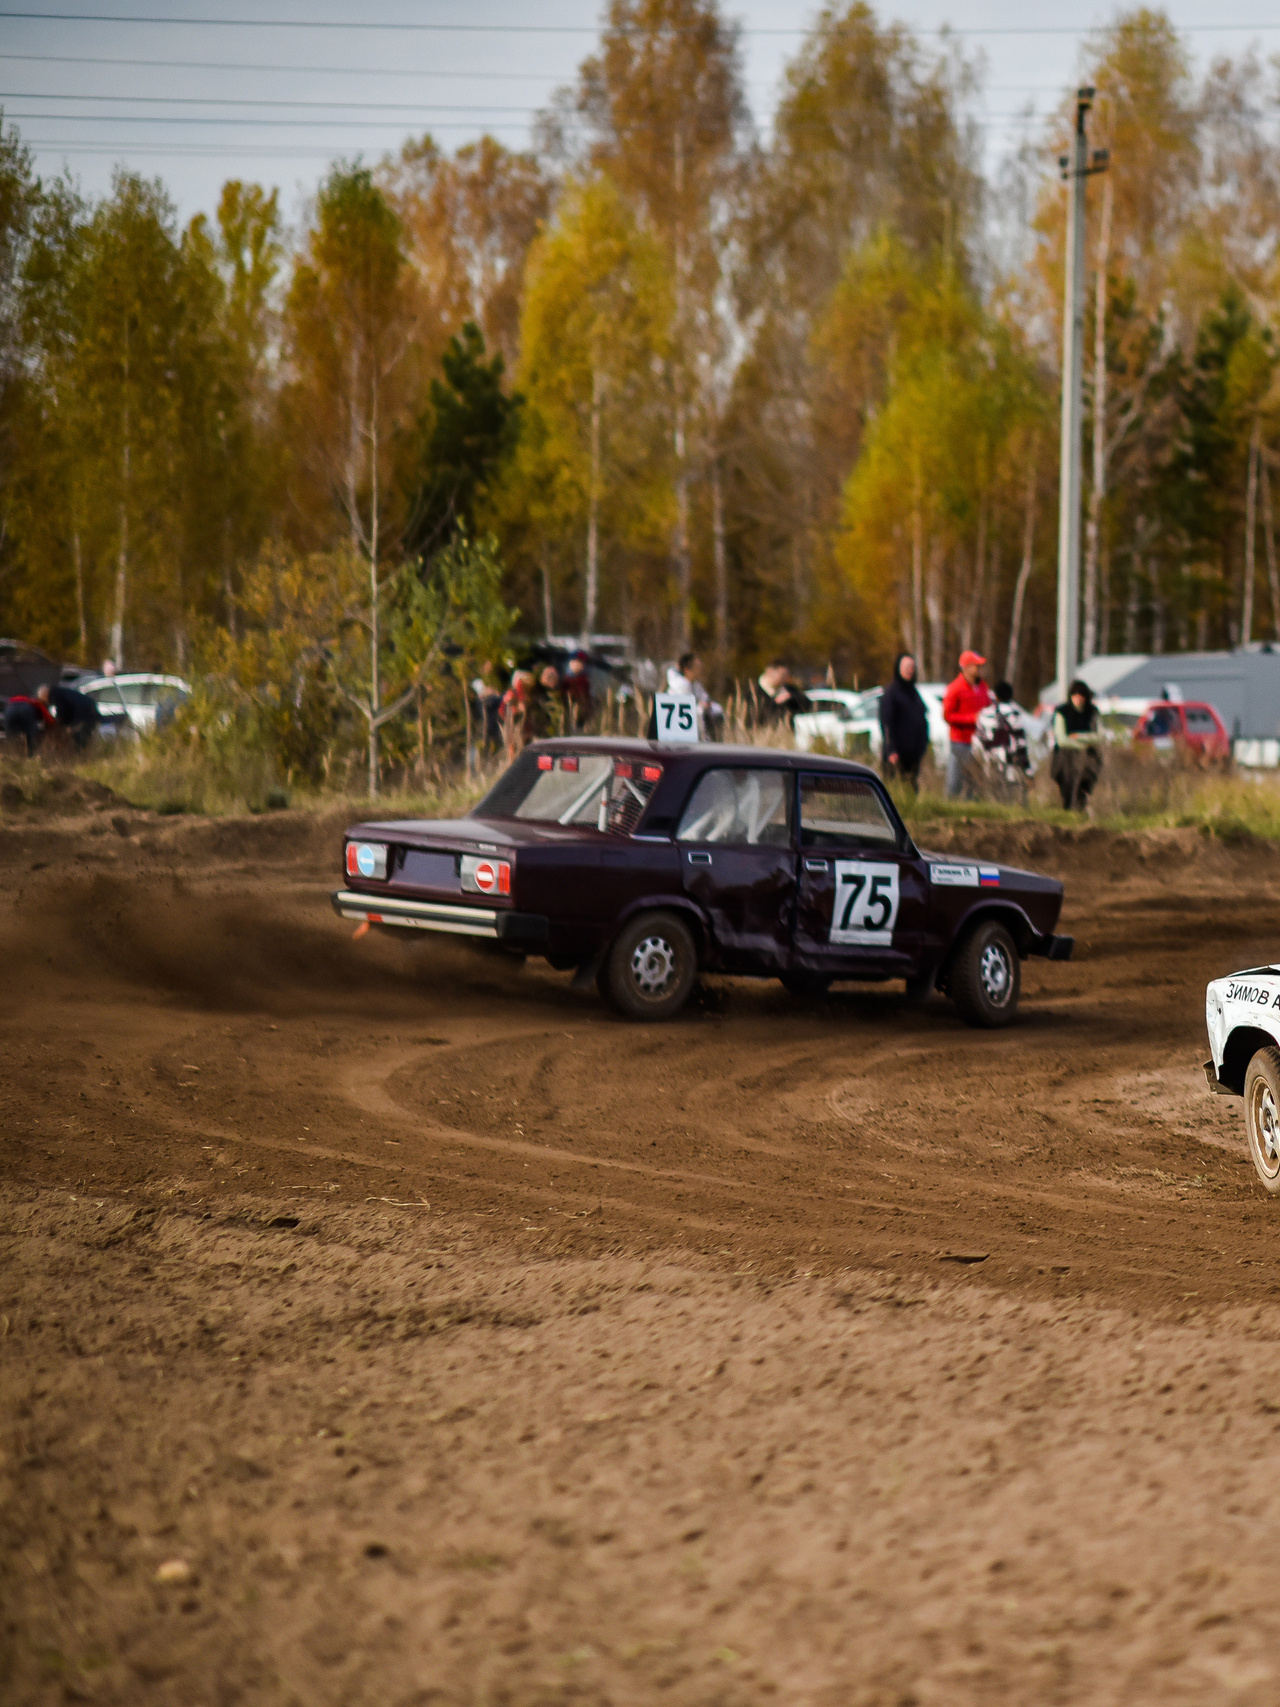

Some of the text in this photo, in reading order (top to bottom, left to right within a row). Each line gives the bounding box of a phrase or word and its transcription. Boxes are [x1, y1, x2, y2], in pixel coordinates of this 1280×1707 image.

[660, 703, 693, 730] 75
[840, 873, 892, 931] 75
[1226, 983, 1270, 1005] ЗИМОВ
